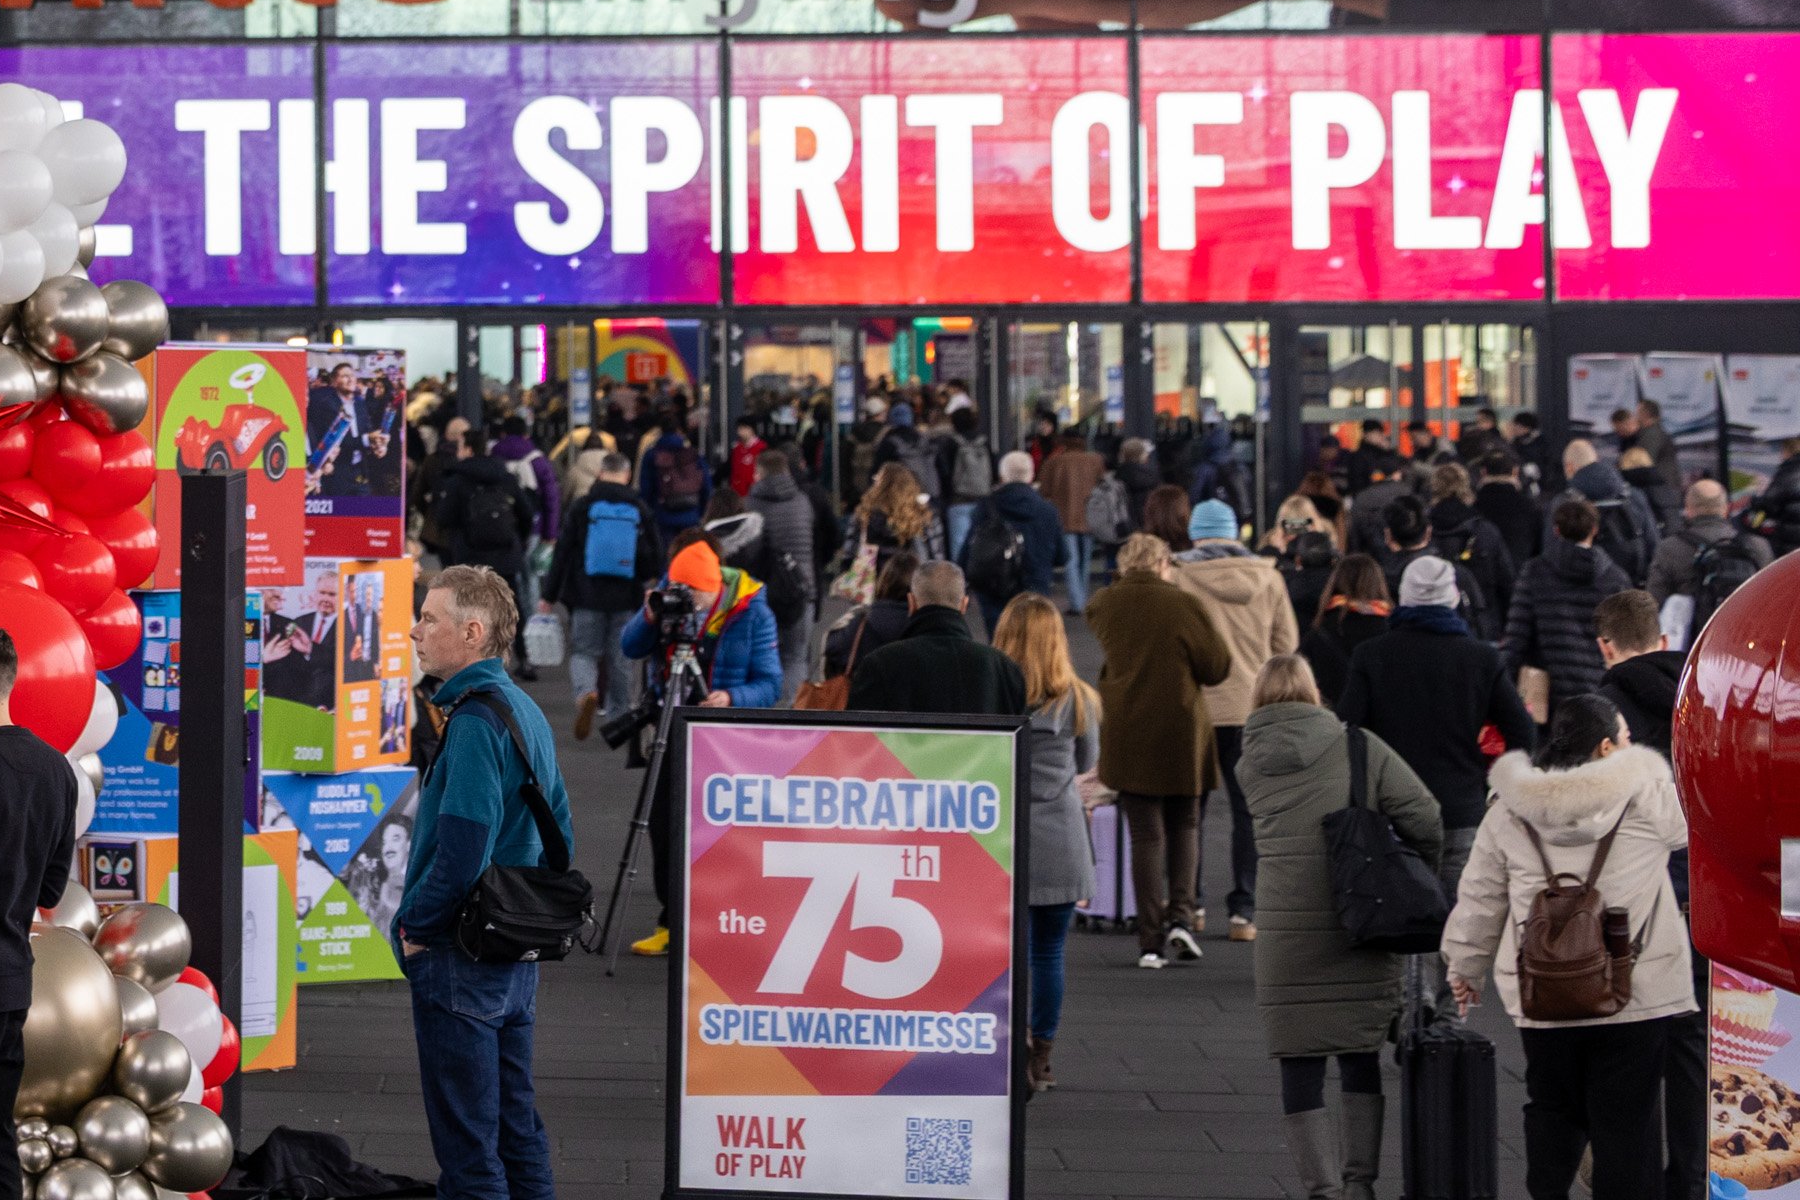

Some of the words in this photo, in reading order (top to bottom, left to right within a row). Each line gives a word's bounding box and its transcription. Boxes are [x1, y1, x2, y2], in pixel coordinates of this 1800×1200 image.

[174, 97, 468, 256] THE
[512, 93, 1003, 255] SPIRIT
[1051, 90, 1244, 252] OF
[1290, 88, 1679, 250] PLAY
[707, 776, 997, 831] CELEBRATING
[718, 908, 767, 936] the
[703, 1008, 994, 1050] SPIELWARENMESSE
[716, 1114, 806, 1150] WALK
[715, 1153, 746, 1176] OF
[749, 1154, 806, 1179] PLAY
